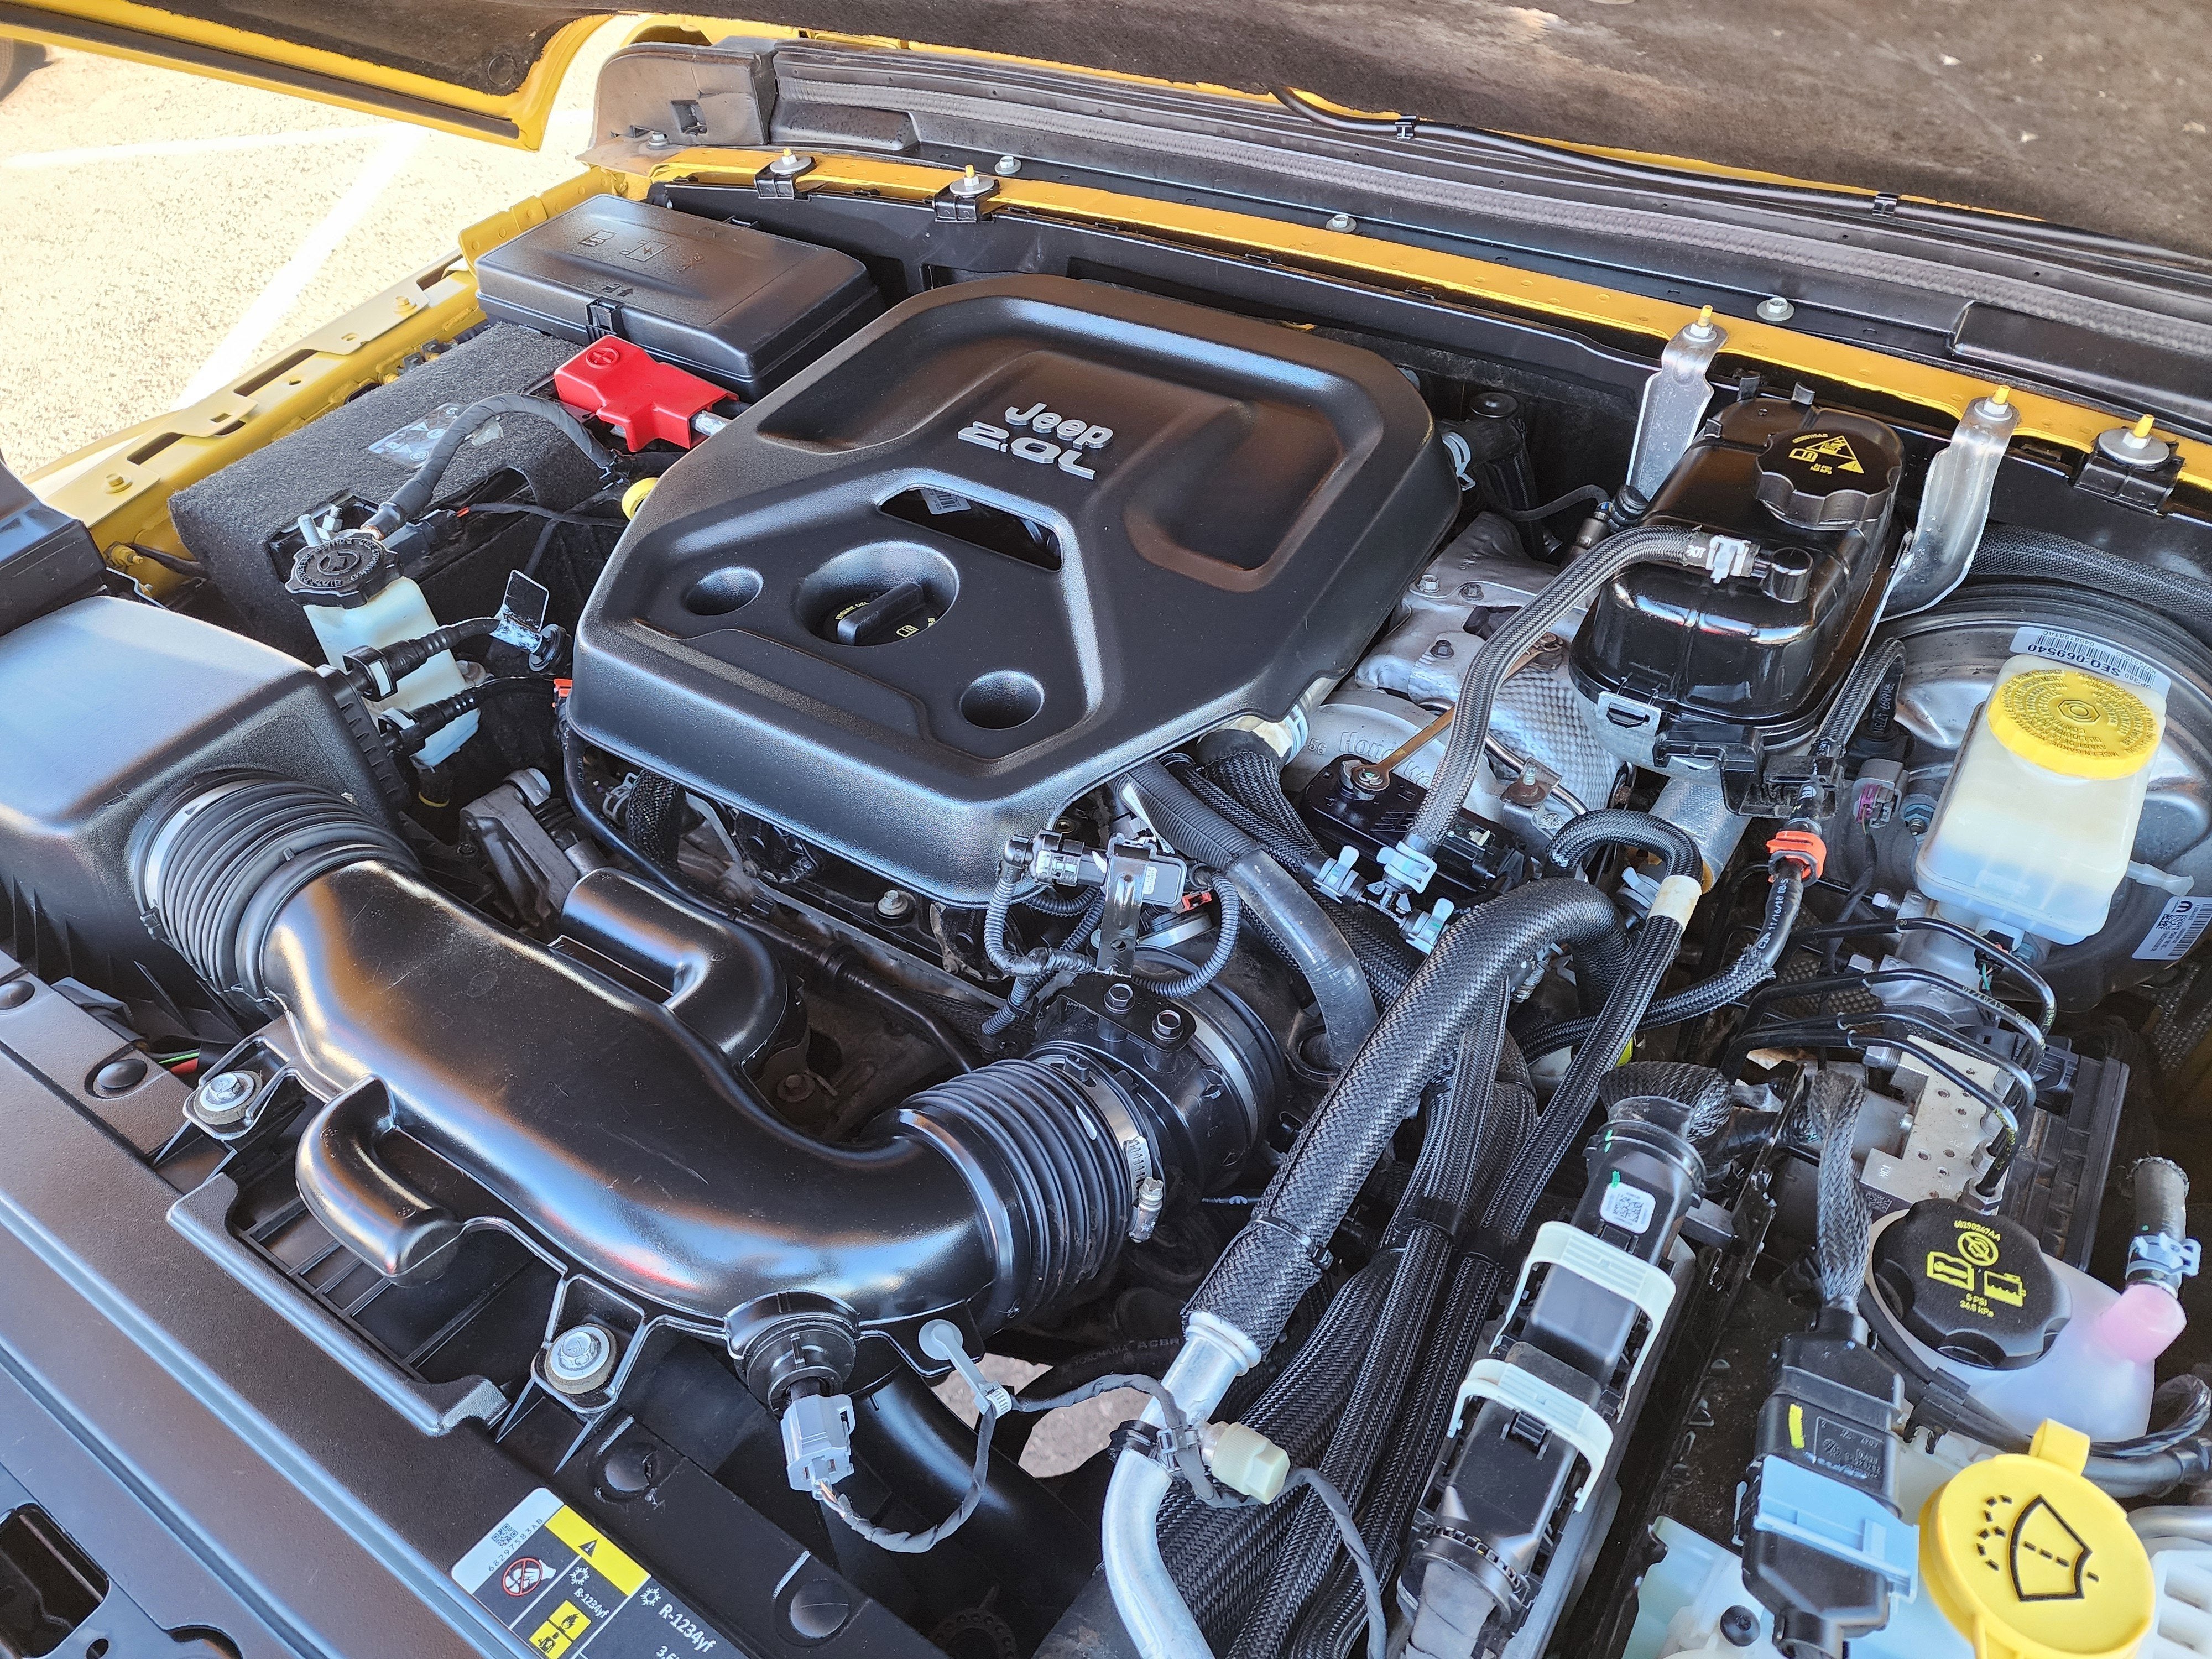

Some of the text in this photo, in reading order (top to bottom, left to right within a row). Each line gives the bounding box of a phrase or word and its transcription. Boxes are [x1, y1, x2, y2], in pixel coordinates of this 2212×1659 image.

[1005, 403, 1113, 449] Jeep
[958, 421, 1095, 480] 2.0L
[2027, 644, 2121, 676] SEQ:069540
[1308, 738, 1327, 755] 56
[1767, 895, 1785, 931] 11/16/18
[1973, 1295, 1987, 1307] PSI
[488, 1518, 543, 1572] 68297583AB
[573, 1587, 610, 1619] R-1234yf
[658, 1603, 718, 1653] R-1234yf
